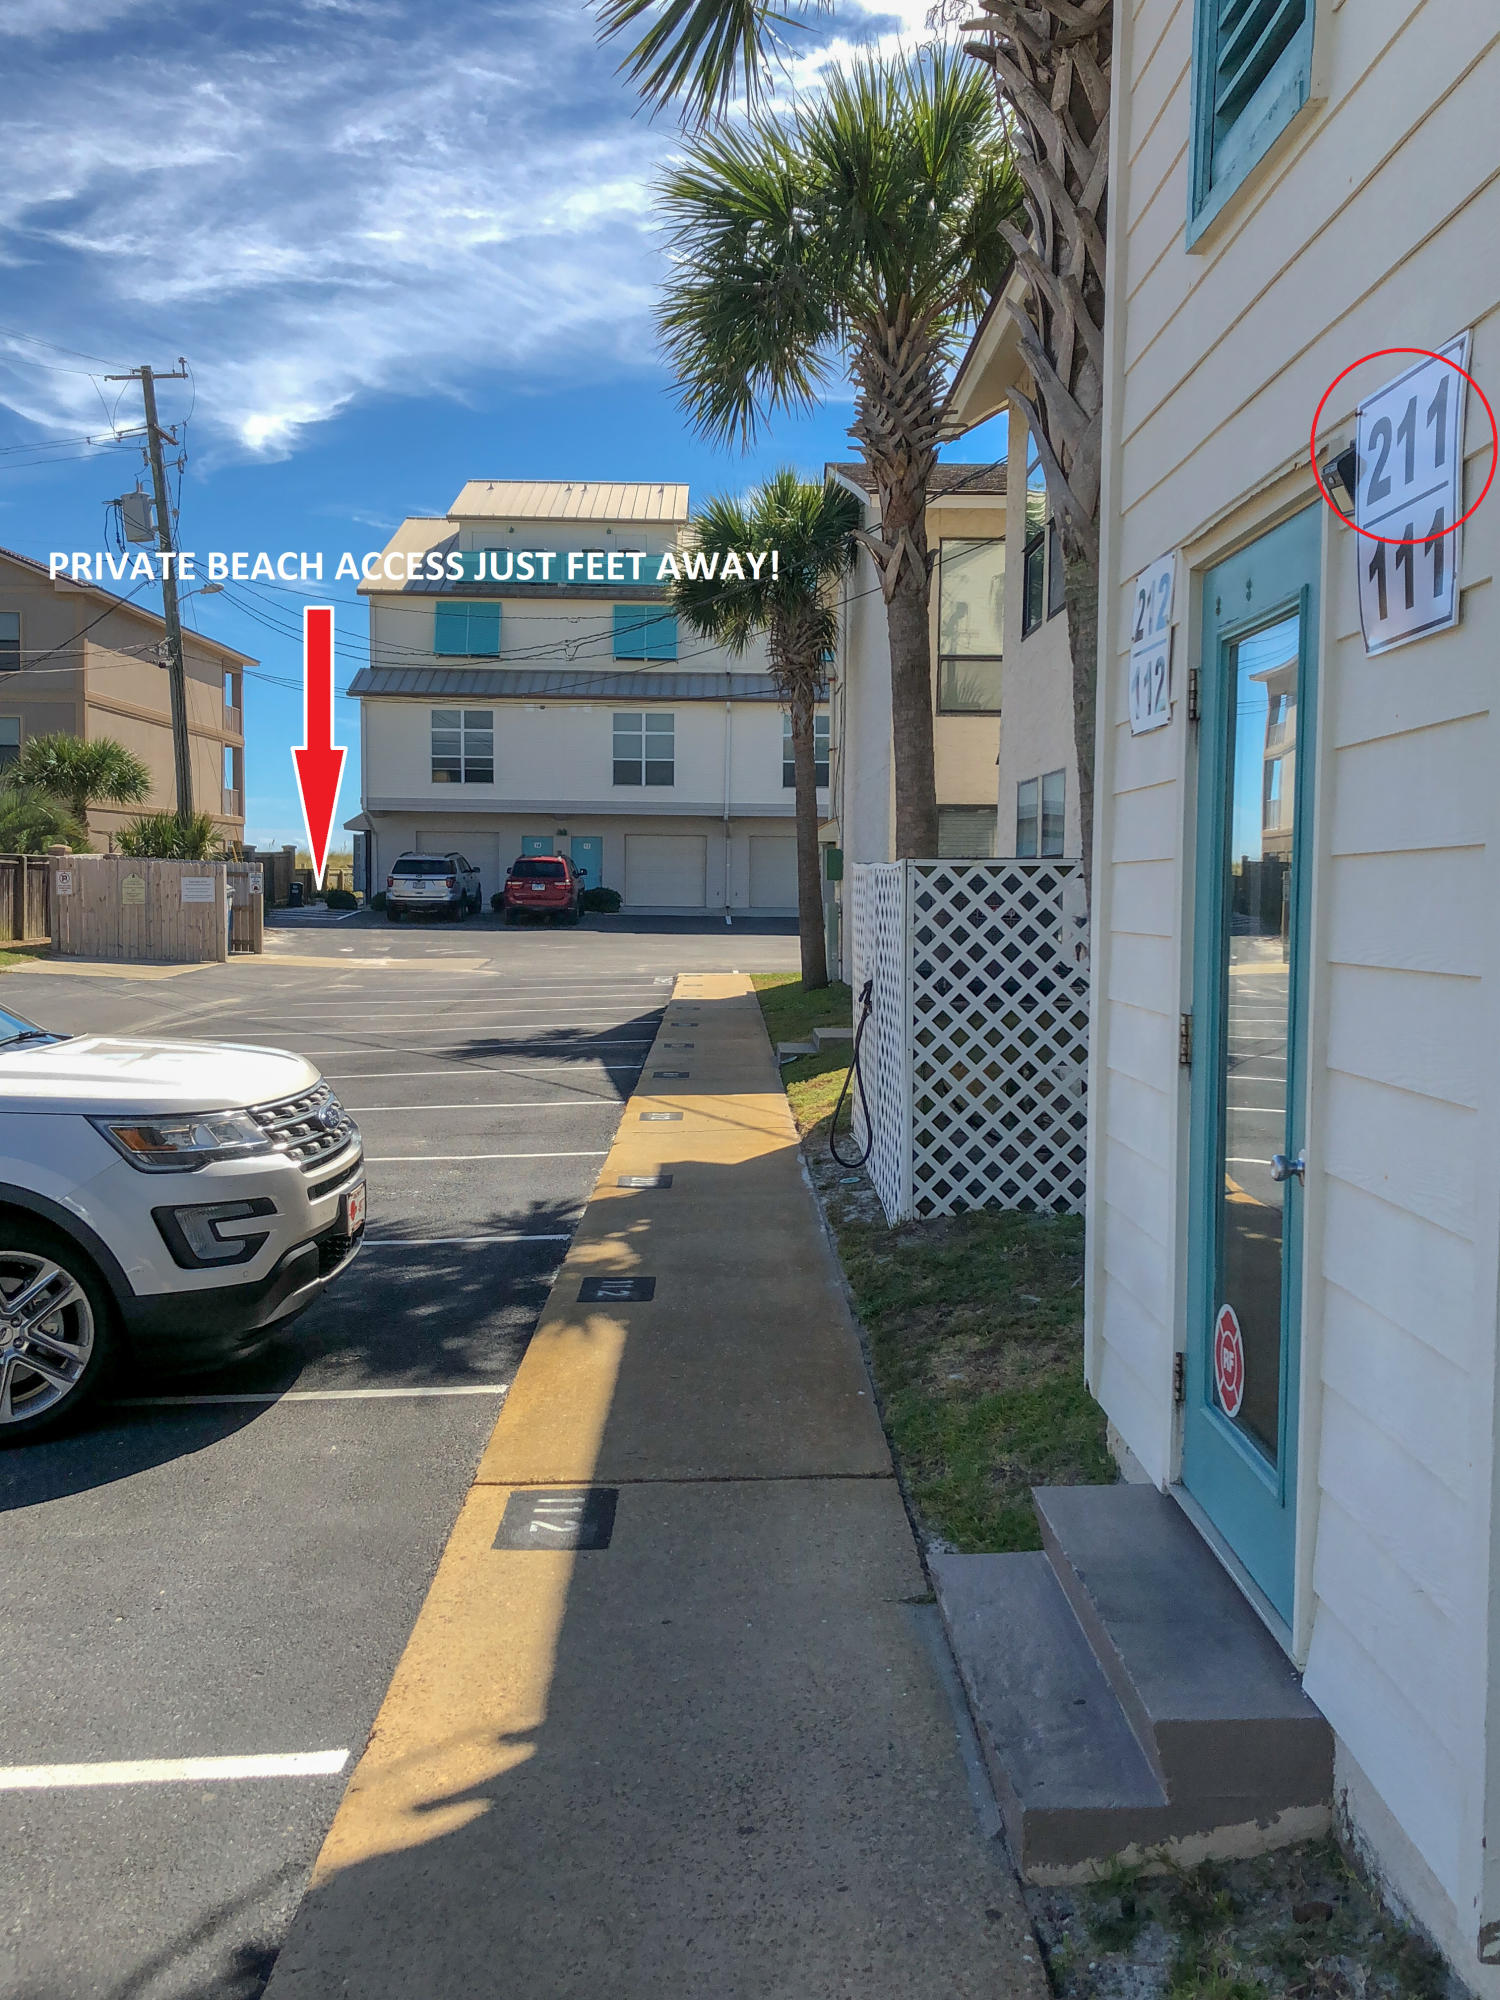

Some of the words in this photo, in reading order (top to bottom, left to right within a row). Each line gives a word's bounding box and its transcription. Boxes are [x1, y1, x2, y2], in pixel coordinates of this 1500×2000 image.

[1366, 374, 1450, 507] 211
[1369, 506, 1445, 621] 111
[1134, 572, 1171, 643] 212
[1131, 655, 1167, 720] 112
[596, 1280, 635, 1297] 112
[529, 1497, 586, 1532] 112
